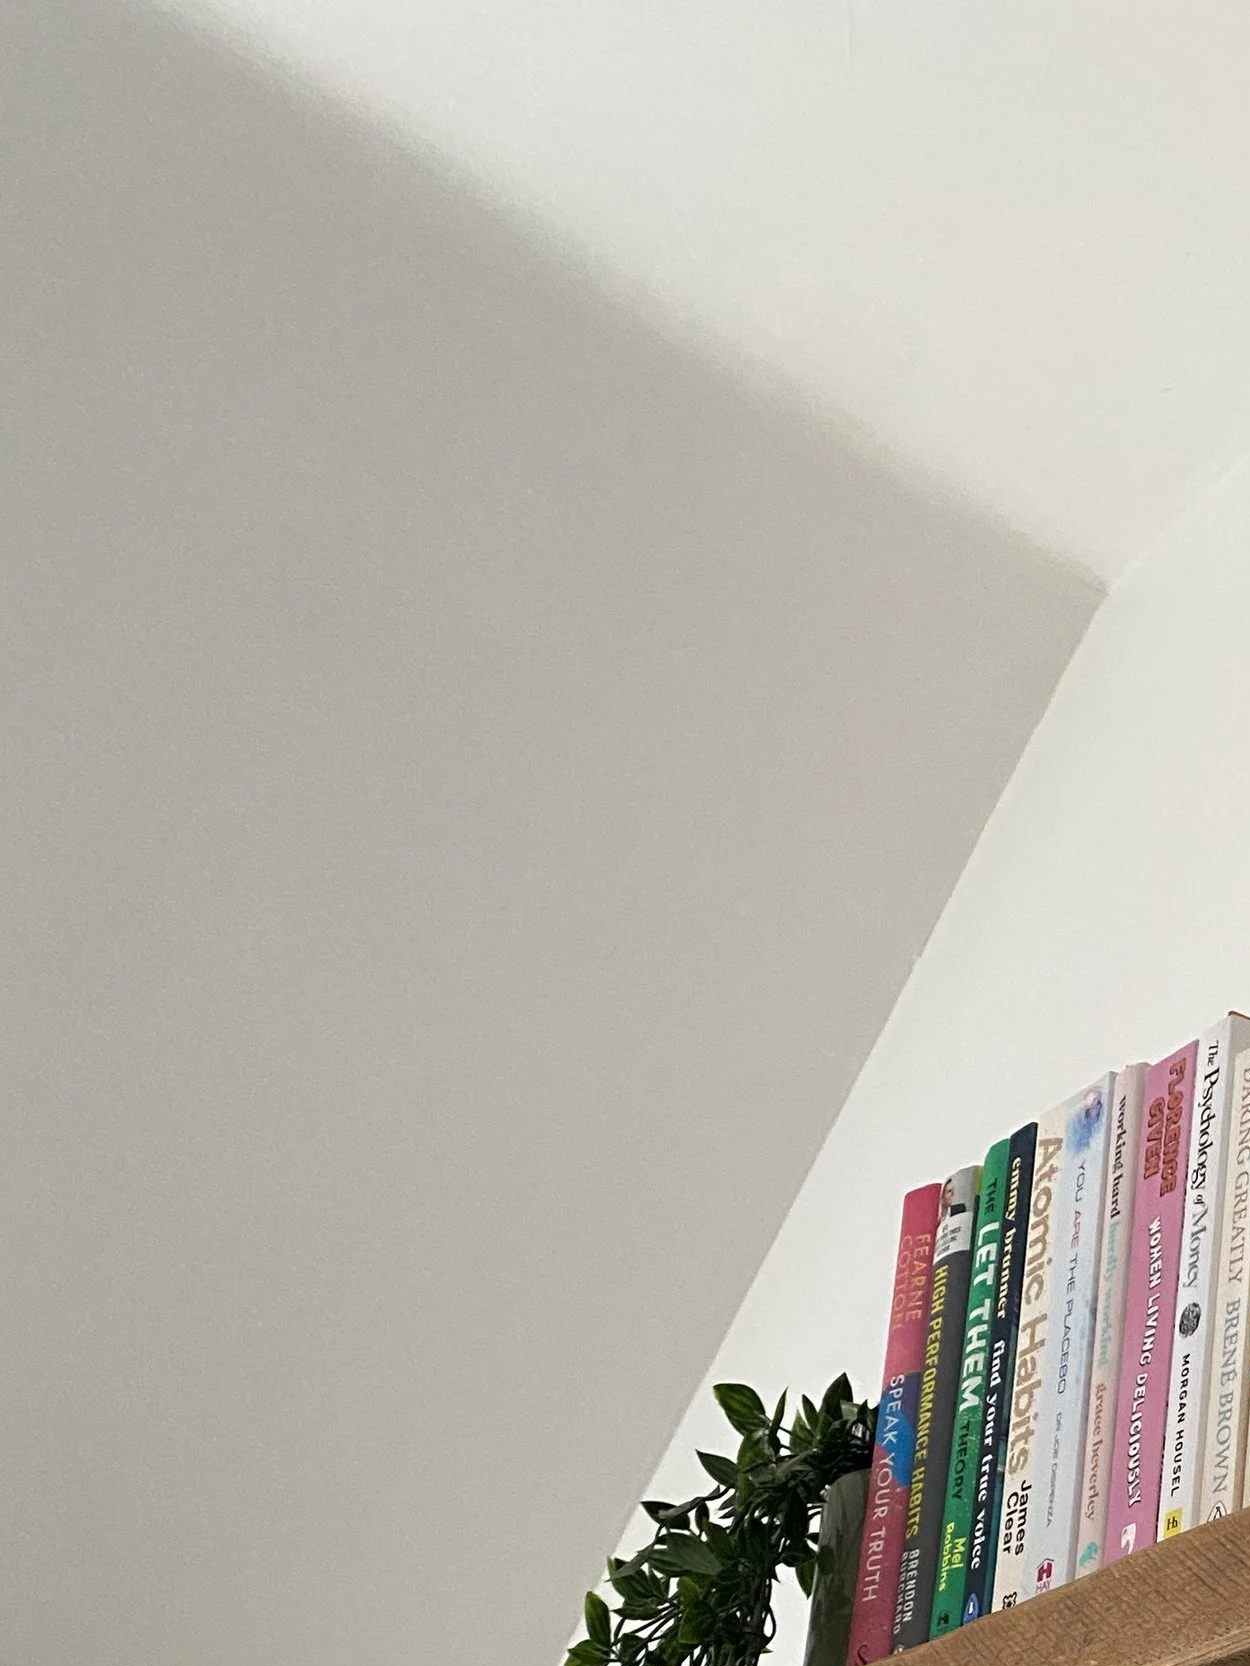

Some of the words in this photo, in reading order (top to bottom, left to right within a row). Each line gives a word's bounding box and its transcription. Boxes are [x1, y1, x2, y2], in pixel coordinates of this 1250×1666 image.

[1206, 1039, 1220, 1067] The
[1111, 1094, 1127, 1180] working
[1143, 1096, 1166, 1180] GIVEN
[1159, 1057, 1188, 1198] FLORENCE
[1188, 1067, 1220, 1190] Psychology
[983, 1177, 998, 1214] THE
[1006, 1156, 1021, 1222] emmy
[1074, 1160, 1086, 1203] YOU
[1110, 1173, 1124, 1219] hard
[1191, 1193, 1204, 1208] of
[972, 1221, 999, 1287] LET
[1024, 1136, 1064, 1305] Atomic
[1070, 1210, 1081, 1246] ARE
[1148, 1216, 1162, 1290] WOMEN
[1182, 1207, 1209, 1290] Money
[1227, 1171, 1250, 1285] GREATLY
[892, 1235, 911, 1330] COTTON
[907, 1234, 931, 1320] FEARNE
[930, 1264, 949, 1313] HIGH
[998, 1227, 1016, 1318] brunner
[1066, 1252, 1078, 1295] THE
[958, 1297, 992, 1412] THEM
[990, 1339, 1005, 1387] find
[1058, 1298, 1074, 1394] PLACEBO
[1139, 1292, 1161, 1367] LIVING
[883, 1372, 905, 1445] SPEAK
[914, 1316, 943, 1464] PERFORMANCE
[983, 1394, 999, 1446] your
[1006, 1313, 1048, 1476] Habits
[1092, 1382, 1107, 1437] grace
[1173, 1352, 1191, 1425] MORGAN
[951, 1420, 971, 1500] THEORY
[1127, 1372, 1148, 1509] DELICIOUSLY
[1171, 1429, 1184, 1498] HOUSEL
[1212, 1390, 1234, 1494] BROWN
[873, 1454, 896, 1519] YOUR
[905, 1467, 925, 1540] HABITS
[978, 1453, 993, 1502] true
[1084, 1439, 1102, 1521] beverley
[949, 1535, 970, 1569] Mel
[971, 1509, 987, 1570] voice
[1002, 1491, 1018, 1554] Clear
[1014, 1480, 1032, 1556] James
[861, 1526, 886, 1602] TRUTH
[902, 1547, 920, 1622] BRENDON
[938, 1521, 956, 1592] Robbins
